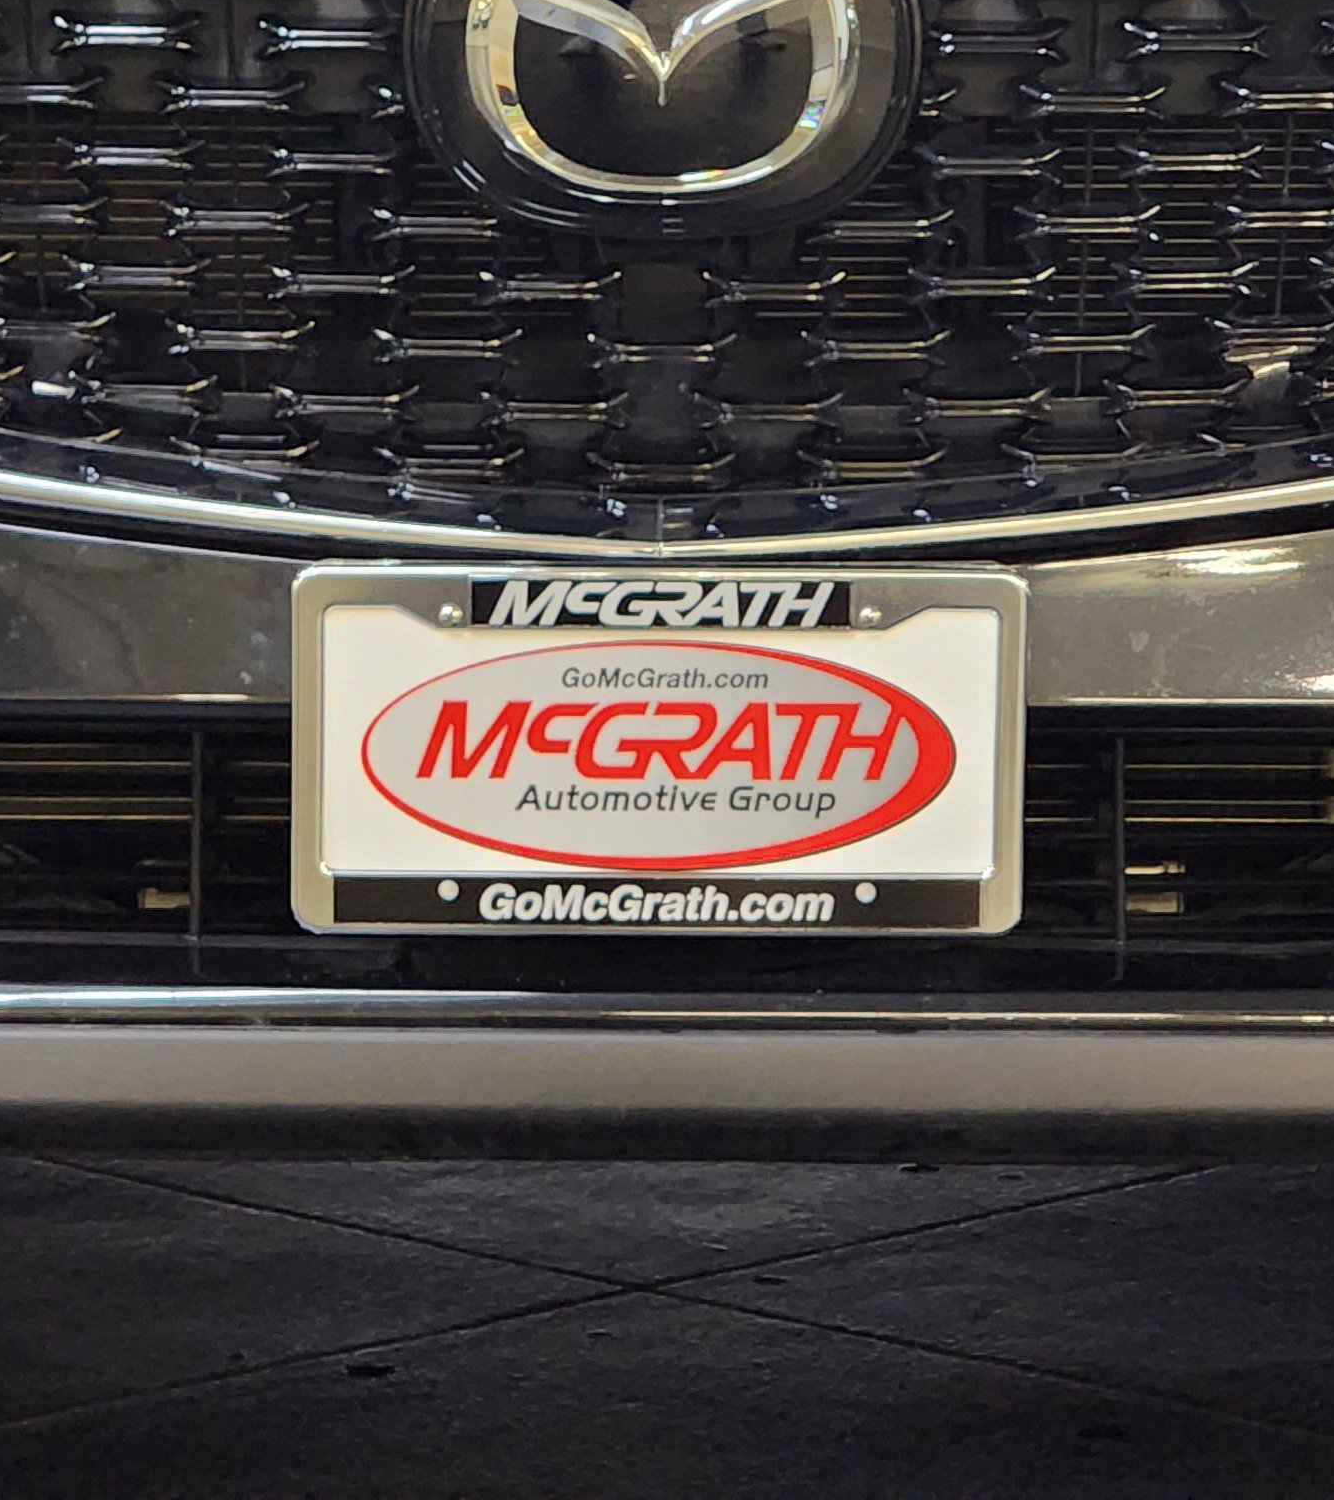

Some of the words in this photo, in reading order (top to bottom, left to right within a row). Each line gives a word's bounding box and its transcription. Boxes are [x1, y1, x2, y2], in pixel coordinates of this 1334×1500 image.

[561, 667, 769, 689] GoMcGrath.com
[515, 784, 718, 812] Automotive
[728, 784, 837, 819] Group
[479, 882, 835, 922] GoMcGrath.com
